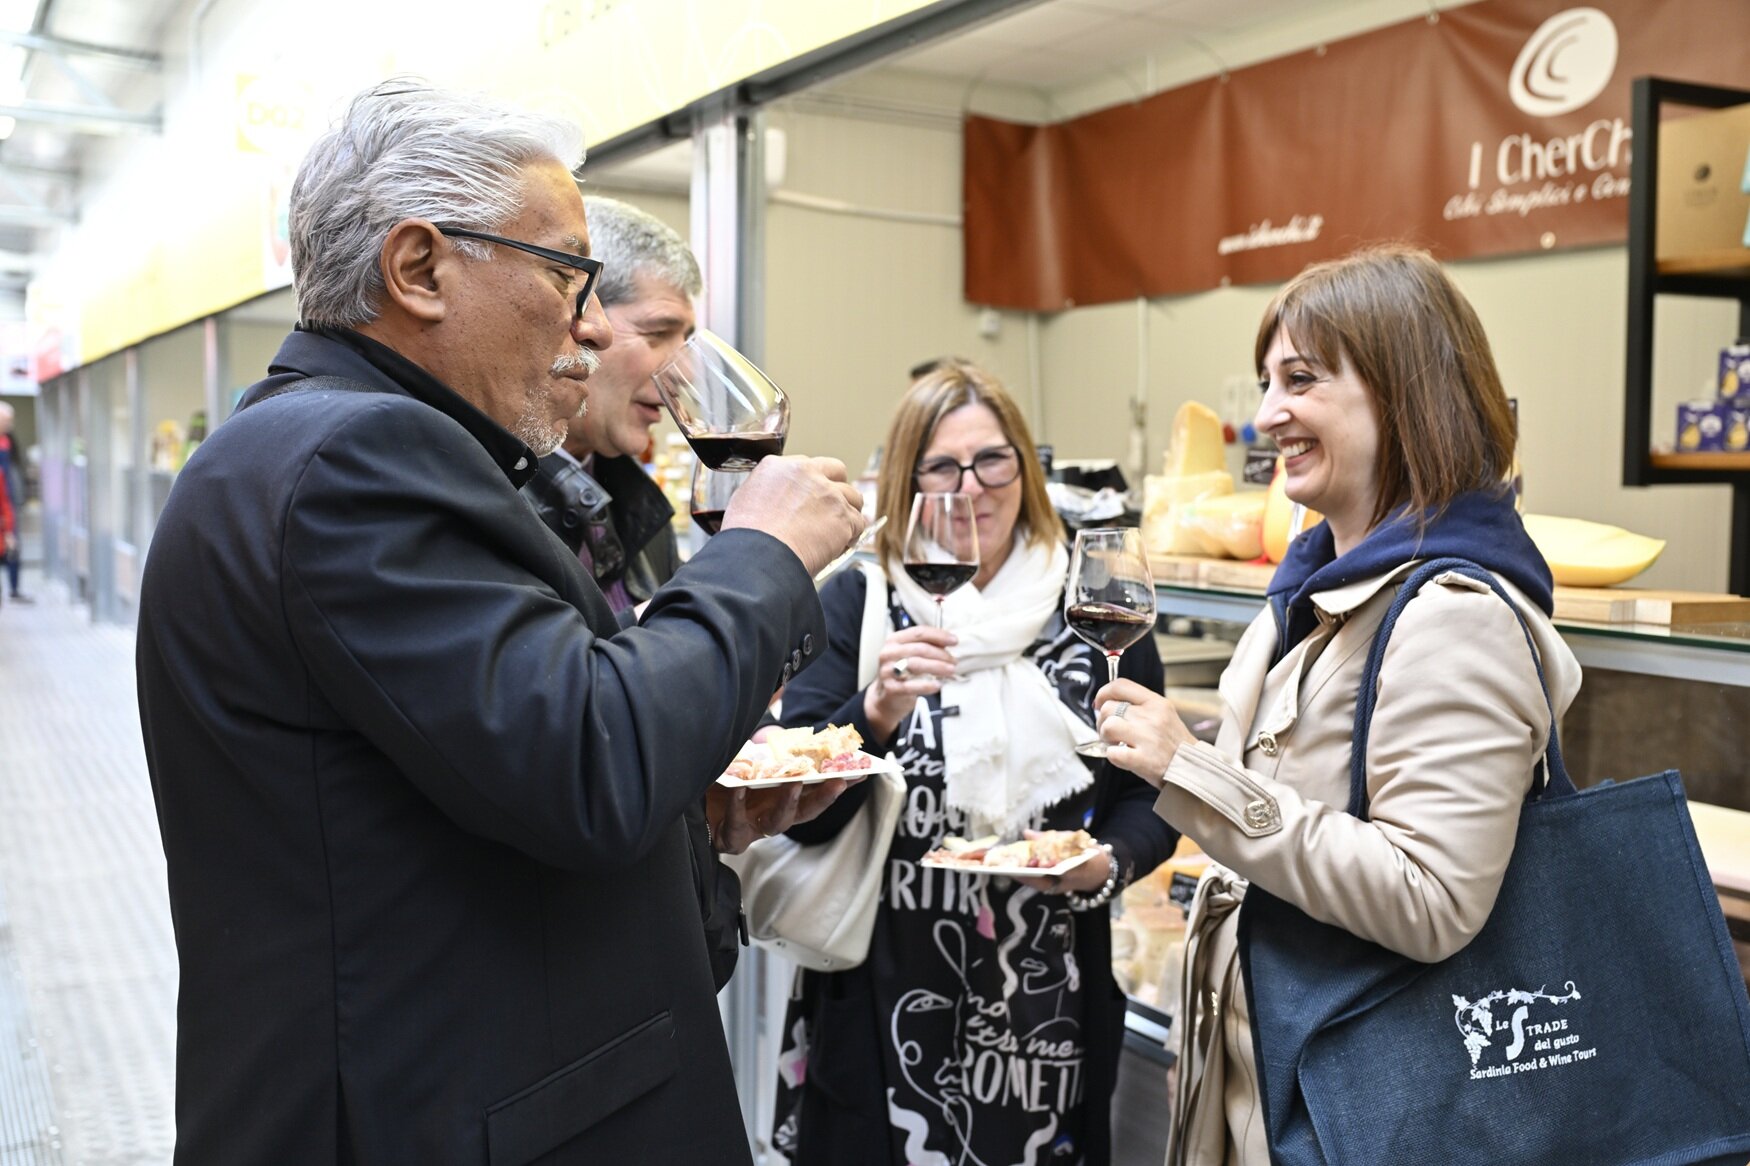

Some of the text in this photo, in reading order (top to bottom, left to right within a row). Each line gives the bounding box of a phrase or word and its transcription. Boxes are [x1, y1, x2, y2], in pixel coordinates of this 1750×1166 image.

[1495, 1020, 1509, 1031] Le
[1534, 1034, 1580, 1051] del gusto
[1470, 1047, 1597, 1080] Sardinia Food & Wine Tours
